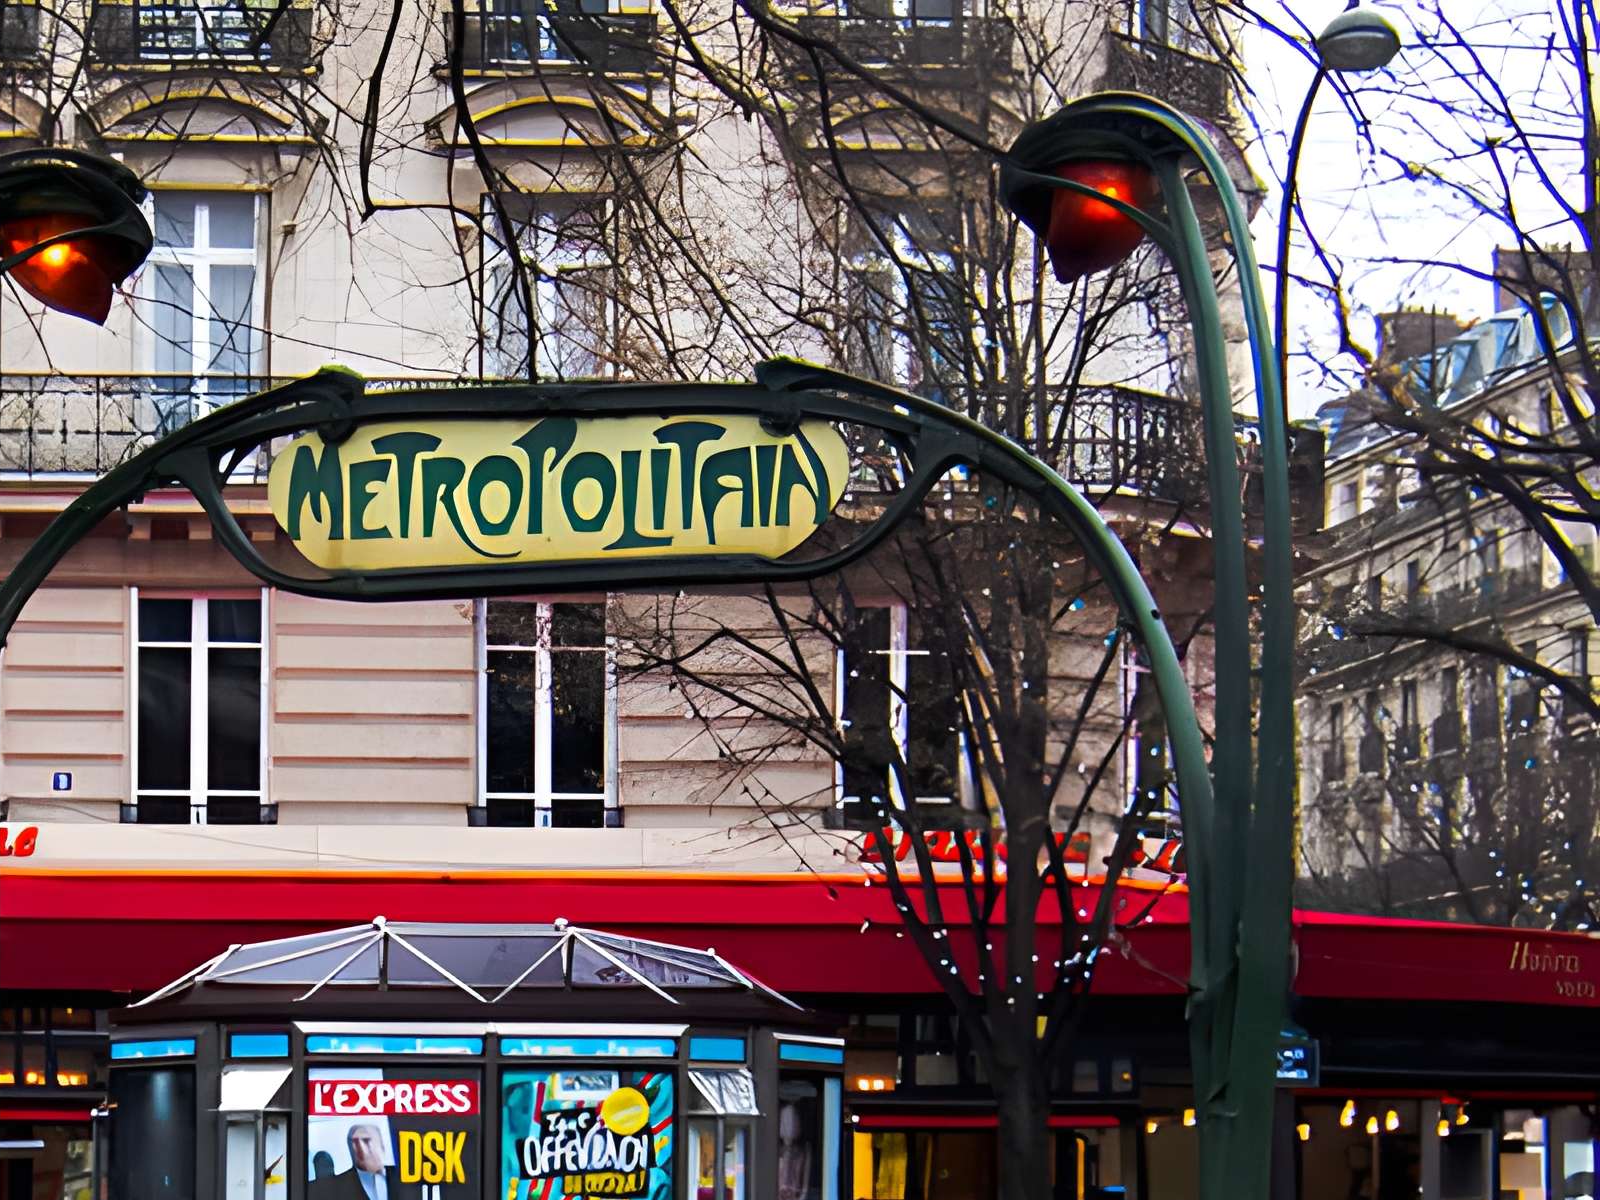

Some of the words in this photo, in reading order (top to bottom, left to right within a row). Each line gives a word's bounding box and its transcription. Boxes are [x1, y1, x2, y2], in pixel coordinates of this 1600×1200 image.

[288, 417, 829, 558] METROPOLITAIN
[314, 1082, 472, 1113] L'EXPRESS
[398, 1130, 468, 1184] DSK
